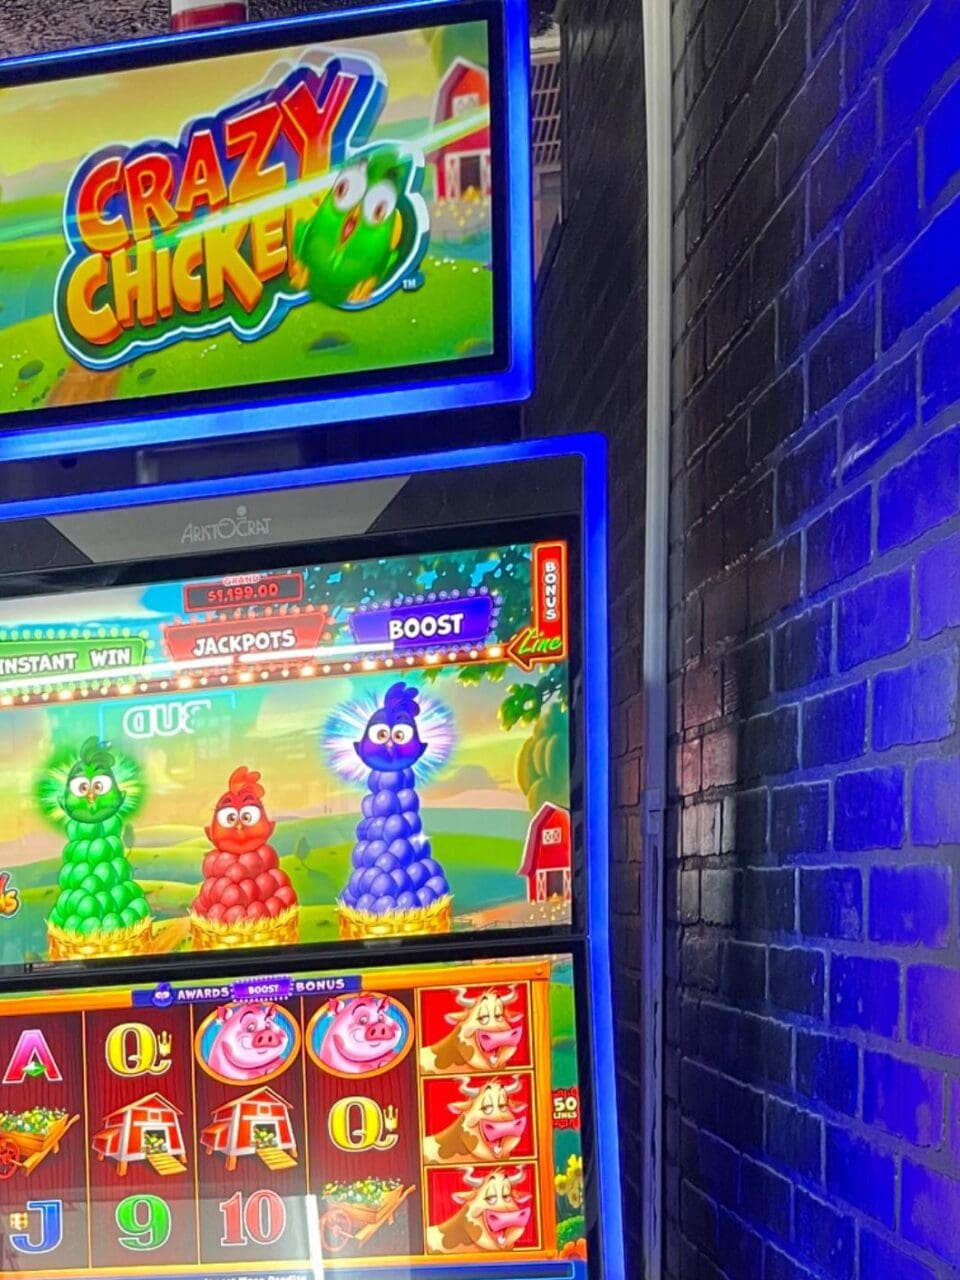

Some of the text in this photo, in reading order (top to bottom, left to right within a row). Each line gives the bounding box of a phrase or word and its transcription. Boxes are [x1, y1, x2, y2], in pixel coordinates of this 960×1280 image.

[76, 70, 360, 252] CRAZY
[223, 575, 261, 586] GRAND
[544, 561, 559, 620] BONUS
[389, 612, 464, 640] BOOST
[518, 626, 562, 655] Line
[192, 628, 296, 657] JACKPOTS
[90, 648, 132, 667] WIN
[177, 986, 230, 1001] AWARDS
[247, 983, 280, 995] BOOST
[296, 979, 346, 992] BONUS
[2, 1029, 63, 1084] A
[105, 1022, 172, 1077] Q
[554, 1096, 577, 1111] 50
[328, 1096, 399, 1152] Q
[9, 1199, 63, 1253] J
[115, 1194, 172, 1251] 9
[219, 1189, 286, 1247] 10
